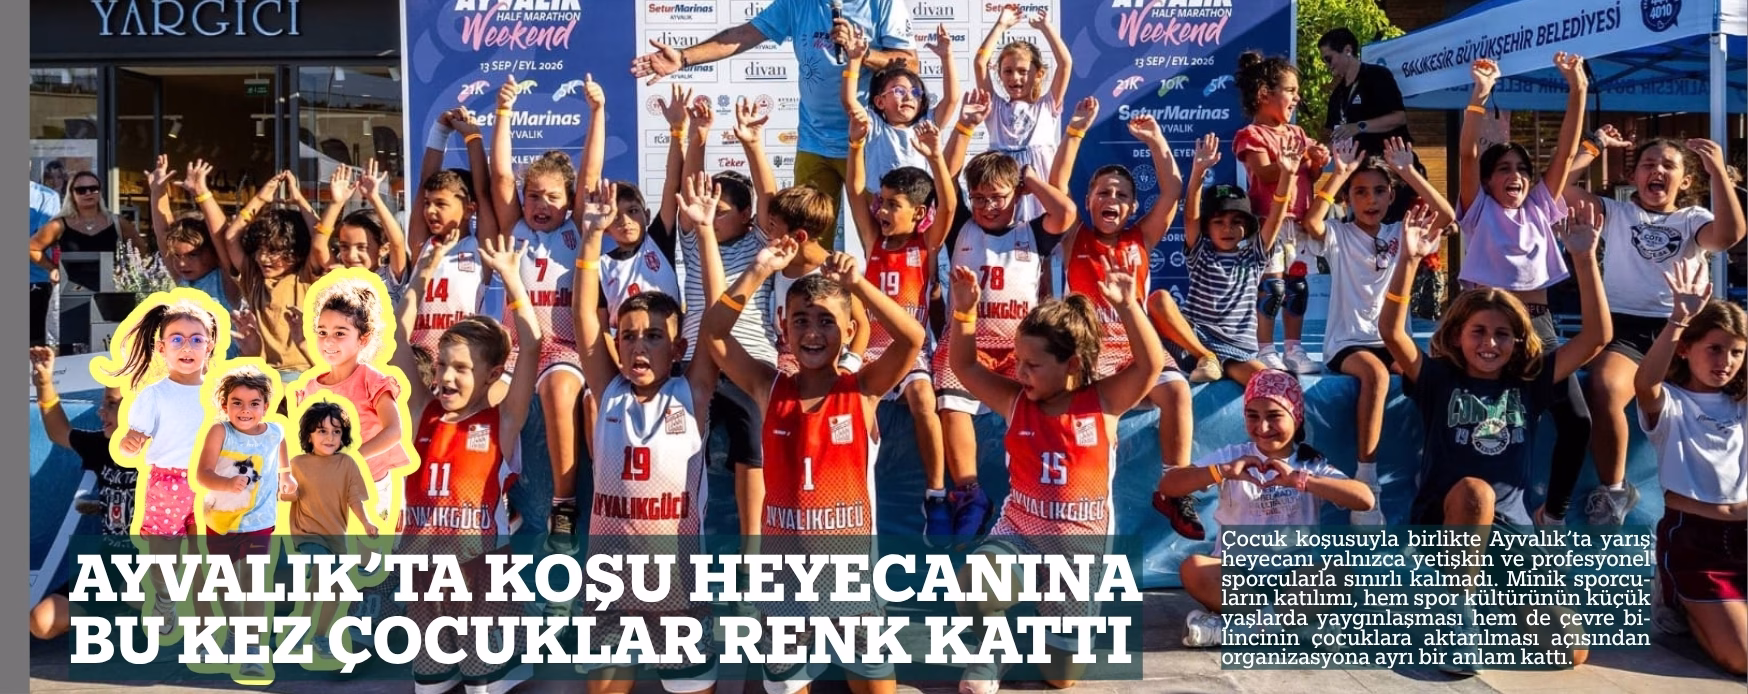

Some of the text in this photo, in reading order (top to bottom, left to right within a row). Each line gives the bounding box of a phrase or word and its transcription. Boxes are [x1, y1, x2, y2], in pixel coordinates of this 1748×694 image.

[91, 0, 300, 36] YARGICI
[496, 12, 581, 21] HALF MARATHON
[649, 3, 713, 13] SeturMarinas
[913, 1, 954, 16] divan
[1151, 8, 1232, 18] HALF MARATHON
[1650, 3, 1672, 20] 4010
[462, 2, 577, 51] Weekend
[1118, 0, 1229, 47] Weekend
[657, 31, 699, 47] divan
[1402, 0, 1621, 78] BALIKESİR BÜYÜKŞEHİR BELEDİYESİ
[480, 62, 490, 73] 13
[492, 61, 511, 70] SEP
[519, 61, 537, 70] EYL
[539, 60, 563, 70] 2026
[745, 61, 787, 77] divan
[1135, 58, 1144, 68] 13
[1146, 56, 1165, 66] SEP
[1172, 56, 1189, 66] EYL
[1191, 55, 1215, 66] 2026
[1117, 77, 1138, 91] 21K
[1161, 77, 1184, 90] 10K
[511, 130, 543, 139] YVALIK
[1161, 124, 1194, 133] YVALIK
[535, 258, 548, 282] 7
[980, 266, 1004, 290] 78
[425, 278, 449, 302] 14
[880, 271, 900, 296] 19
[621, 446, 650, 482] 19
[803, 457, 814, 490] 1
[1041, 451, 1067, 485] 15
[428, 463, 451, 496] 11
[766, 501, 864, 530] AYVALIKGÜCÜ
